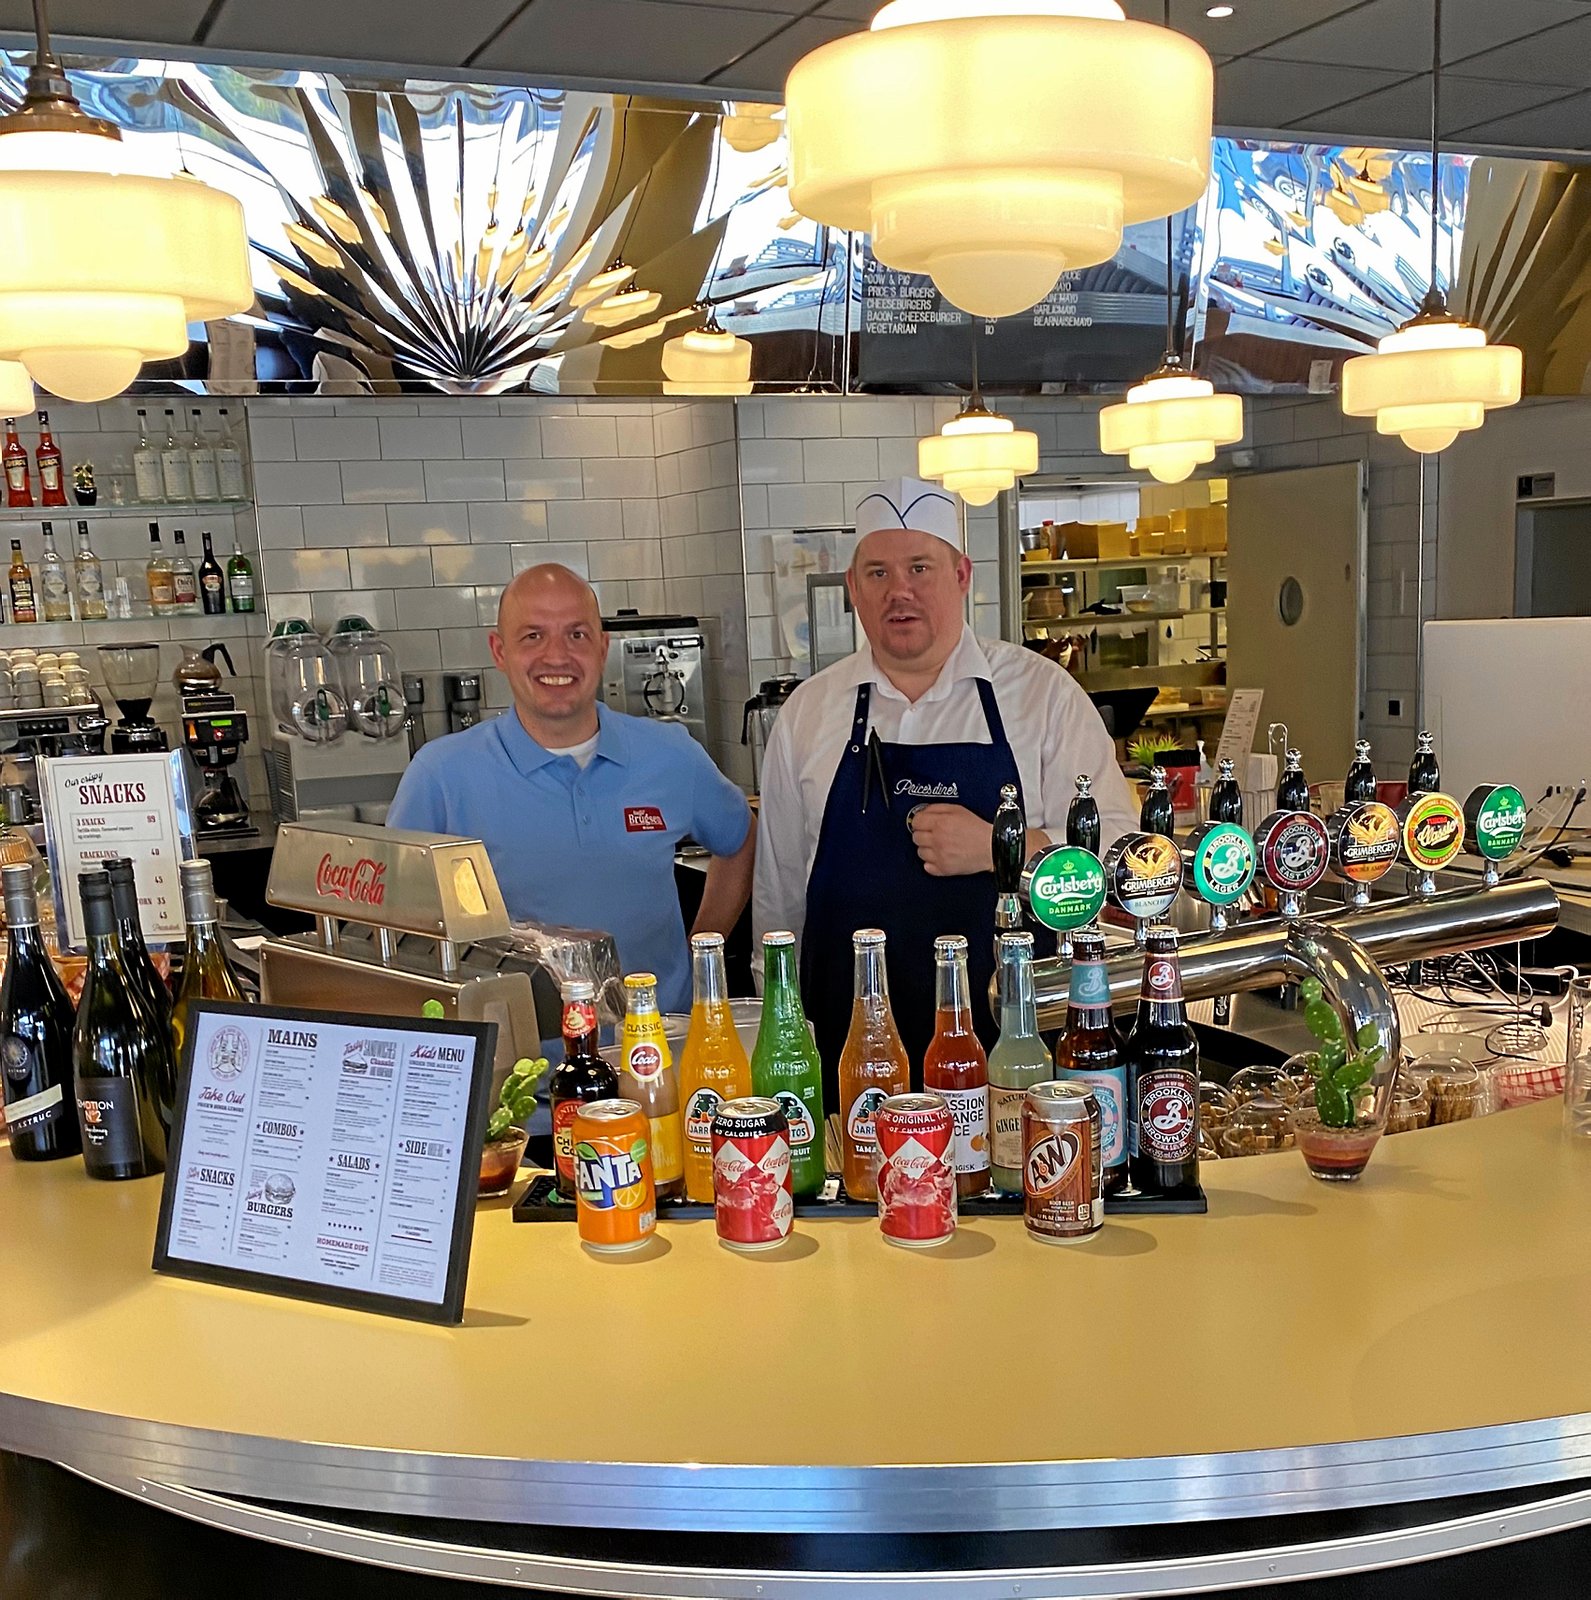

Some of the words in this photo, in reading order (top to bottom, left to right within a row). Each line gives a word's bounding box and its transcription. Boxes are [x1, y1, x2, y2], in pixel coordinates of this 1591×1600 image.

[900, 287, 935, 298] BURGERS
[867, 299, 931, 310] CHEESEBURGERS
[866, 323, 917, 334] VEGETARIAN
[65, 777, 79, 788] Our
[80, 771, 104, 785] crispy
[78, 782, 146, 805] SNACKS
[1279, 824, 1319, 843] BROOKLYN
[1417, 819, 1458, 847] Classic
[1207, 834, 1250, 857] BROOKLYN
[1346, 843, 1395, 858] GRIMBERGEN
[316, 852, 388, 906] Coca-Cola
[1279, 865, 1301, 880] EAST
[1304, 865, 1318, 879] IPA
[1036, 870, 1103, 902] Carlsberg
[1124, 874, 1178, 892] GRIMBERGEN
[1209, 879, 1240, 893] LAGER
[1049, 903, 1091, 915] DANMARK
[626, 1021, 661, 1033] CLASSIC
[267, 1029, 318, 1048] MAINS
[410, 1044, 437, 1060] Kids
[438, 1047, 465, 1063] MENU
[199, 1086, 224, 1102] Take
[225, 1090, 246, 1105] Out
[1144, 1088, 1191, 1106] BROOKLYN
[716, 1116, 733, 1127] ZERO
[734, 1117, 767, 1128] SUGAR
[880, 1110, 891, 1121] THE
[892, 1114, 936, 1125] ORIGINAL
[936, 1109, 948, 1119] TAS
[953, 1109, 984, 1124] ANGE
[262, 1120, 298, 1137] COMBOS
[689, 1126, 709, 1134] JARR
[791, 1127, 806, 1137] TOS
[954, 1125, 970, 1137] CE
[996, 1117, 1020, 1134] GINGE
[1144, 1121, 1180, 1143] BROWN
[1181, 1119, 1194, 1138] ALE
[724, 1129, 765, 1139] CALORIES
[405, 1139, 428, 1155] SIDE
[693, 1145, 711, 1153] MAN
[855, 1145, 876, 1153] TAMA
[337, 1154, 371, 1171] SALADS
[715, 1157, 746, 1173] Coca-Cola
[893, 1155, 930, 1169] Coca-Cola
[1029, 1134, 1067, 1192] A&W
[199, 1168, 235, 1186] SNACKS
[575, 1153, 643, 1192] ANTA
[246, 1201, 294, 1218] BURGERS
[316, 1237, 353, 1250] HOMEMADE
